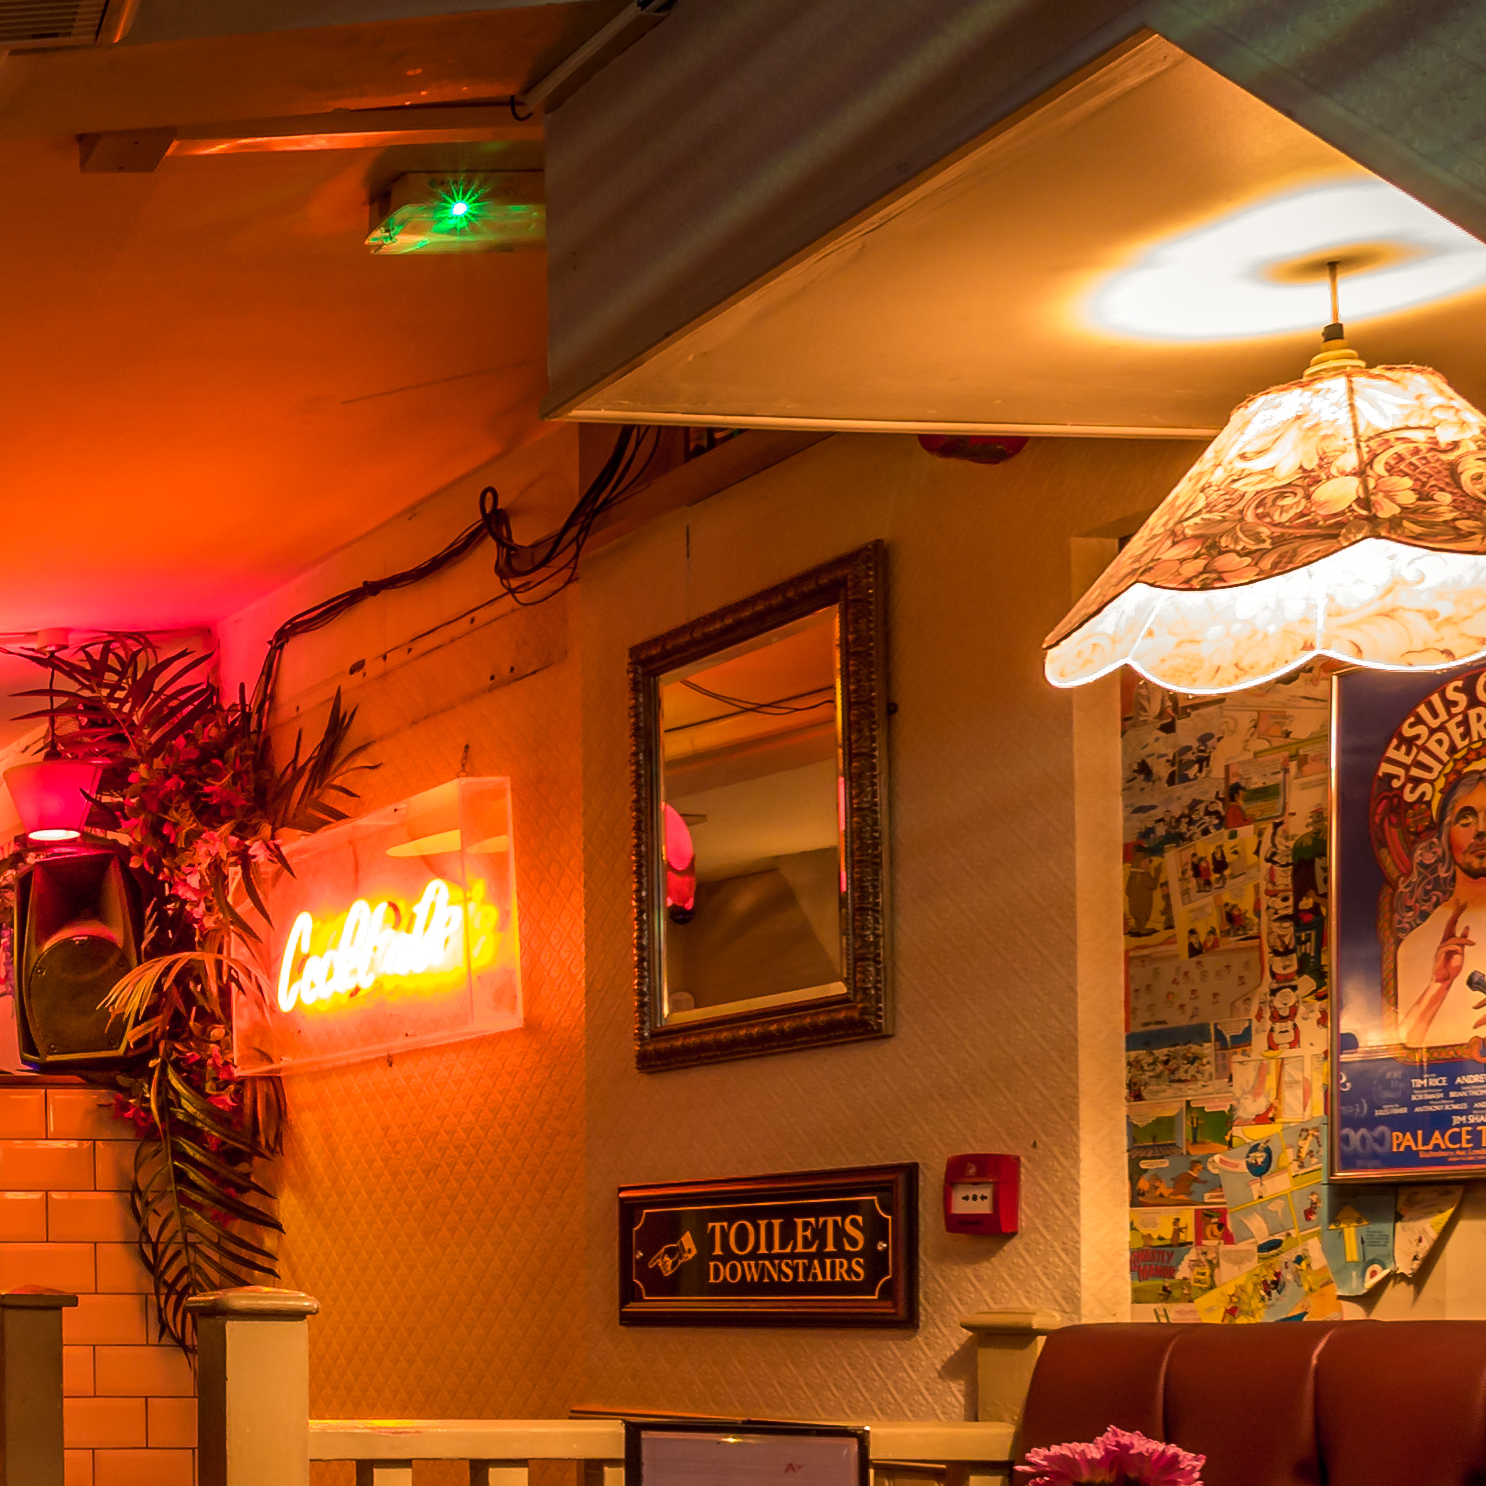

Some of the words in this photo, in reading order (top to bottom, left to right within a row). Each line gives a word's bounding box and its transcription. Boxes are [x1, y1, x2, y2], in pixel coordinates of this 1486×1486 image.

[1378, 680, 1468, 788] JESUS
[1403, 706, 1486, 802] SUPER
[1391, 1126, 1474, 1152] PALACE
[708, 1214, 865, 1256] TOILETS
[708, 1257, 865, 1283] DOWNSTAIRS
